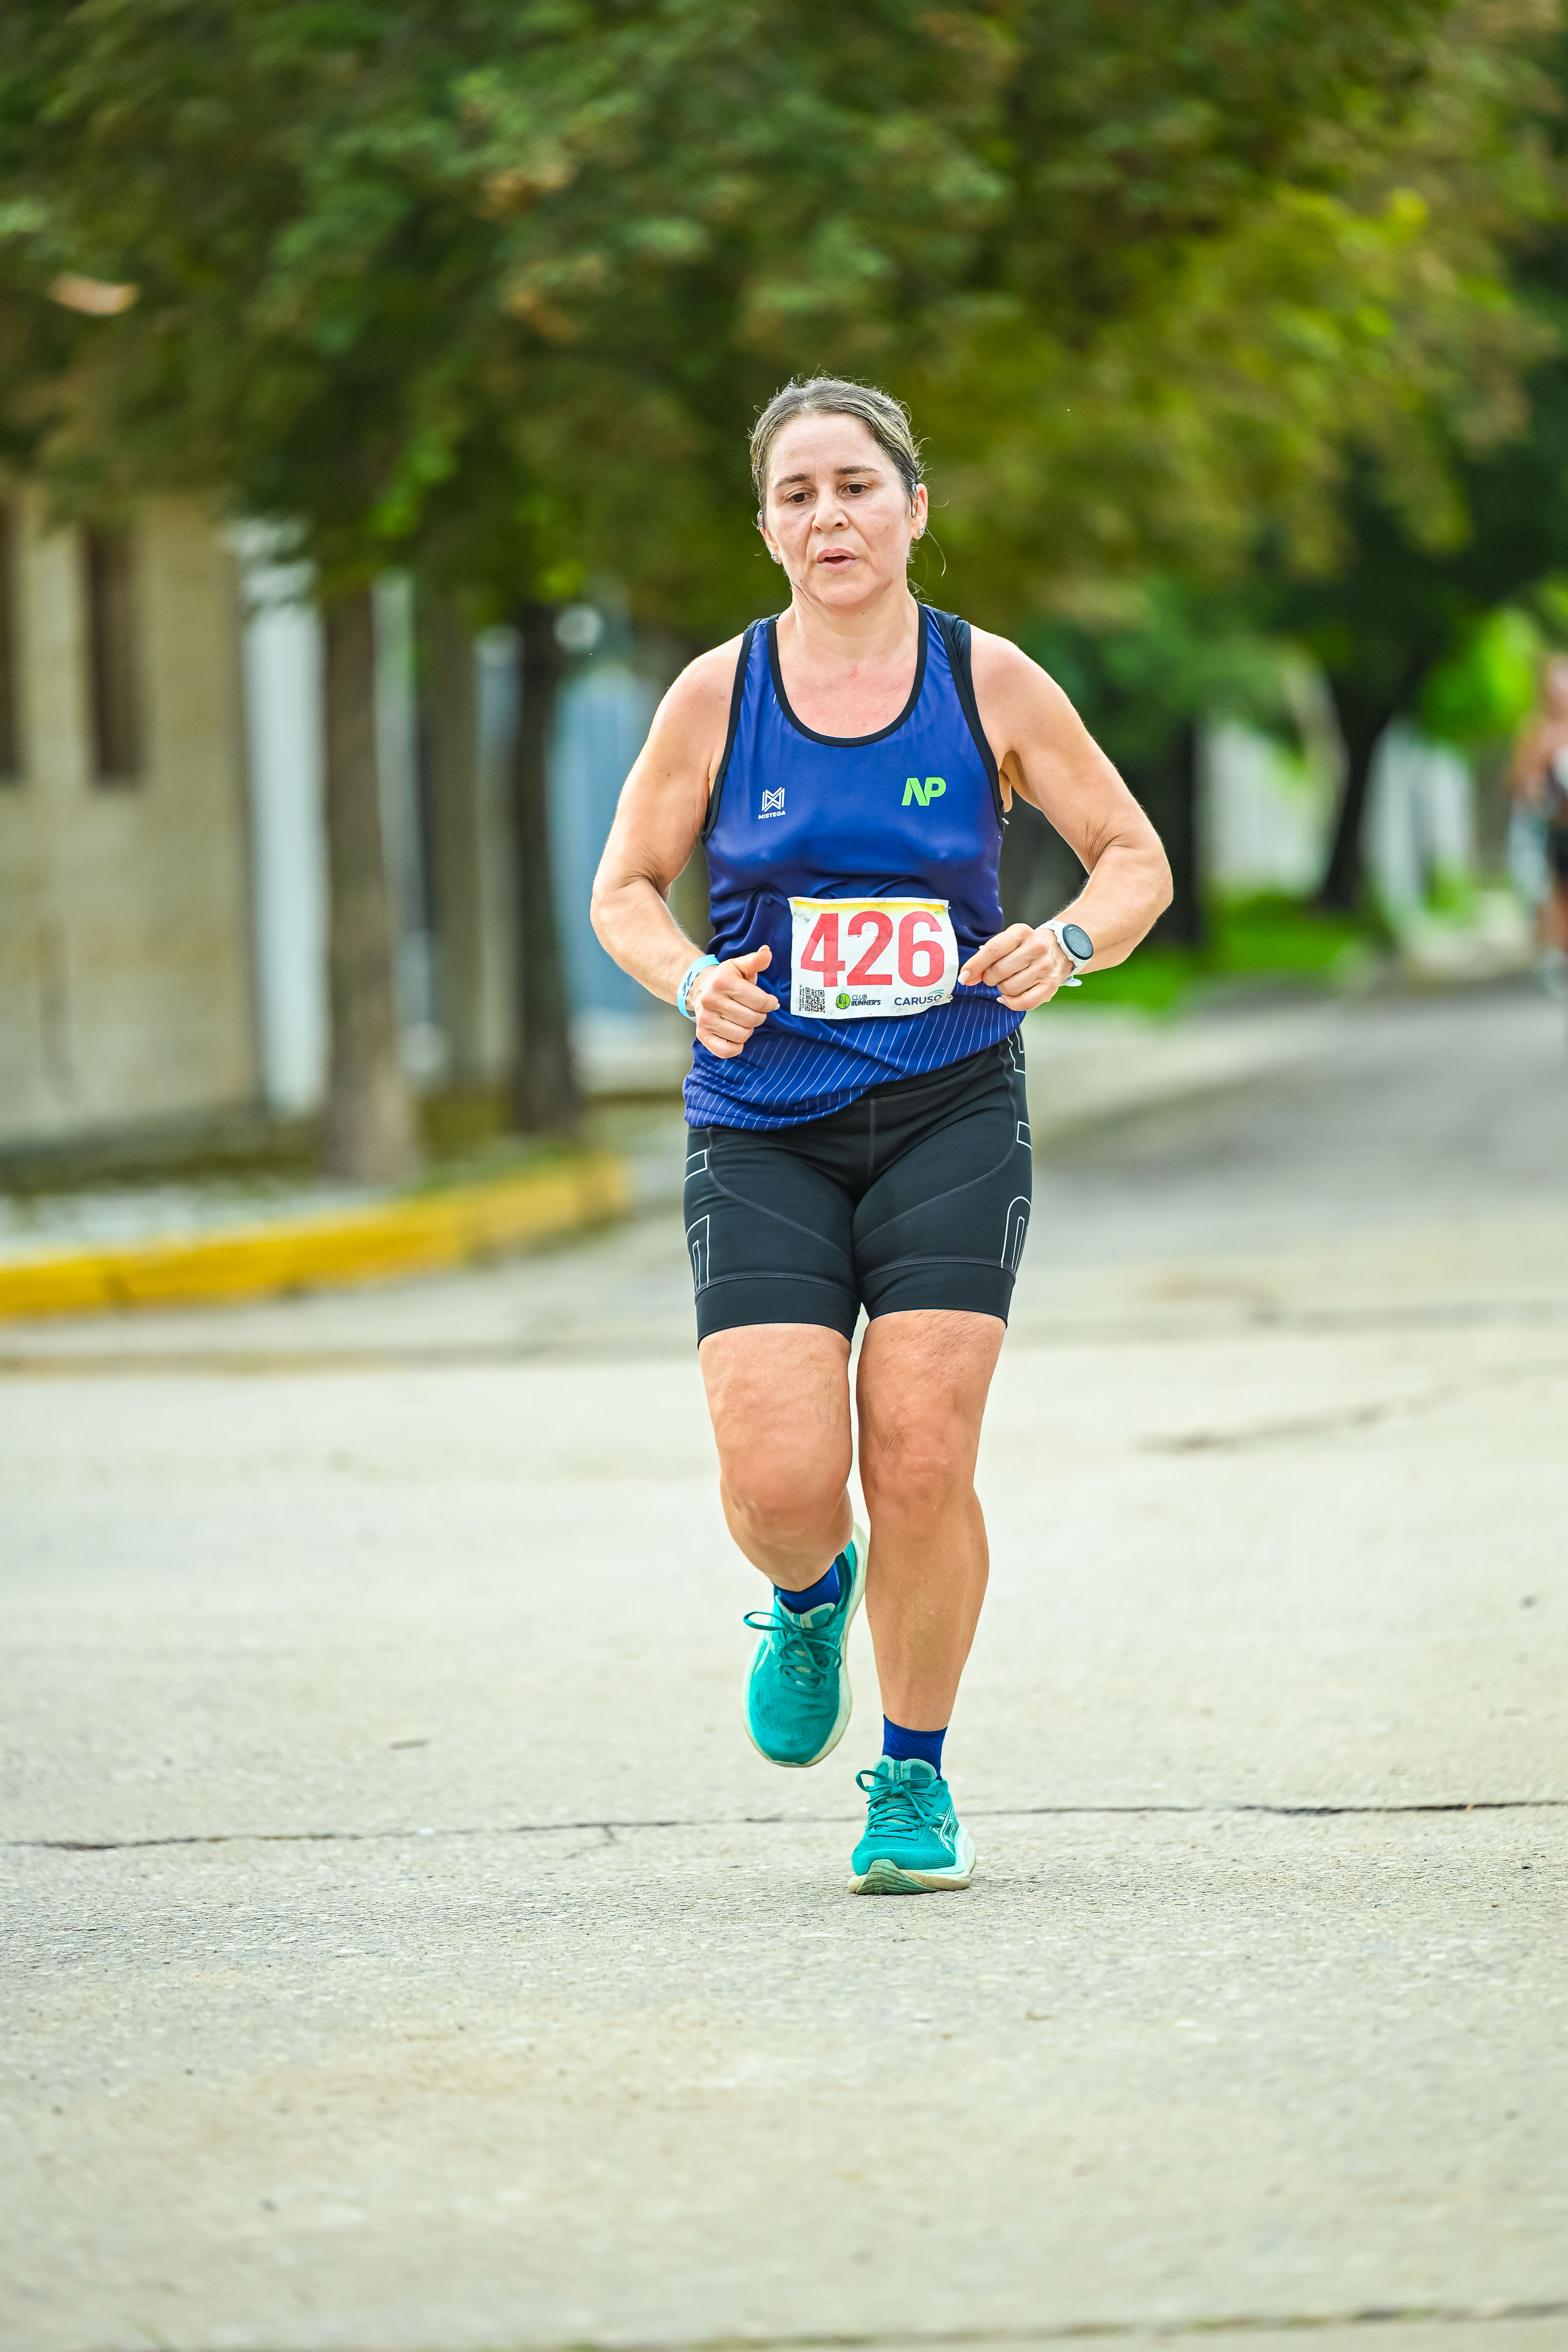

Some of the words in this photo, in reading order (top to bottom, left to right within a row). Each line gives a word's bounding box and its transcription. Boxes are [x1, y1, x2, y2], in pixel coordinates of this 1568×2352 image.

[901, 777, 946, 806] NP
[758, 810, 786, 820] MISTEGA
[801, 911, 944, 987] 426
[894, 994, 942, 1006] CARUSO
